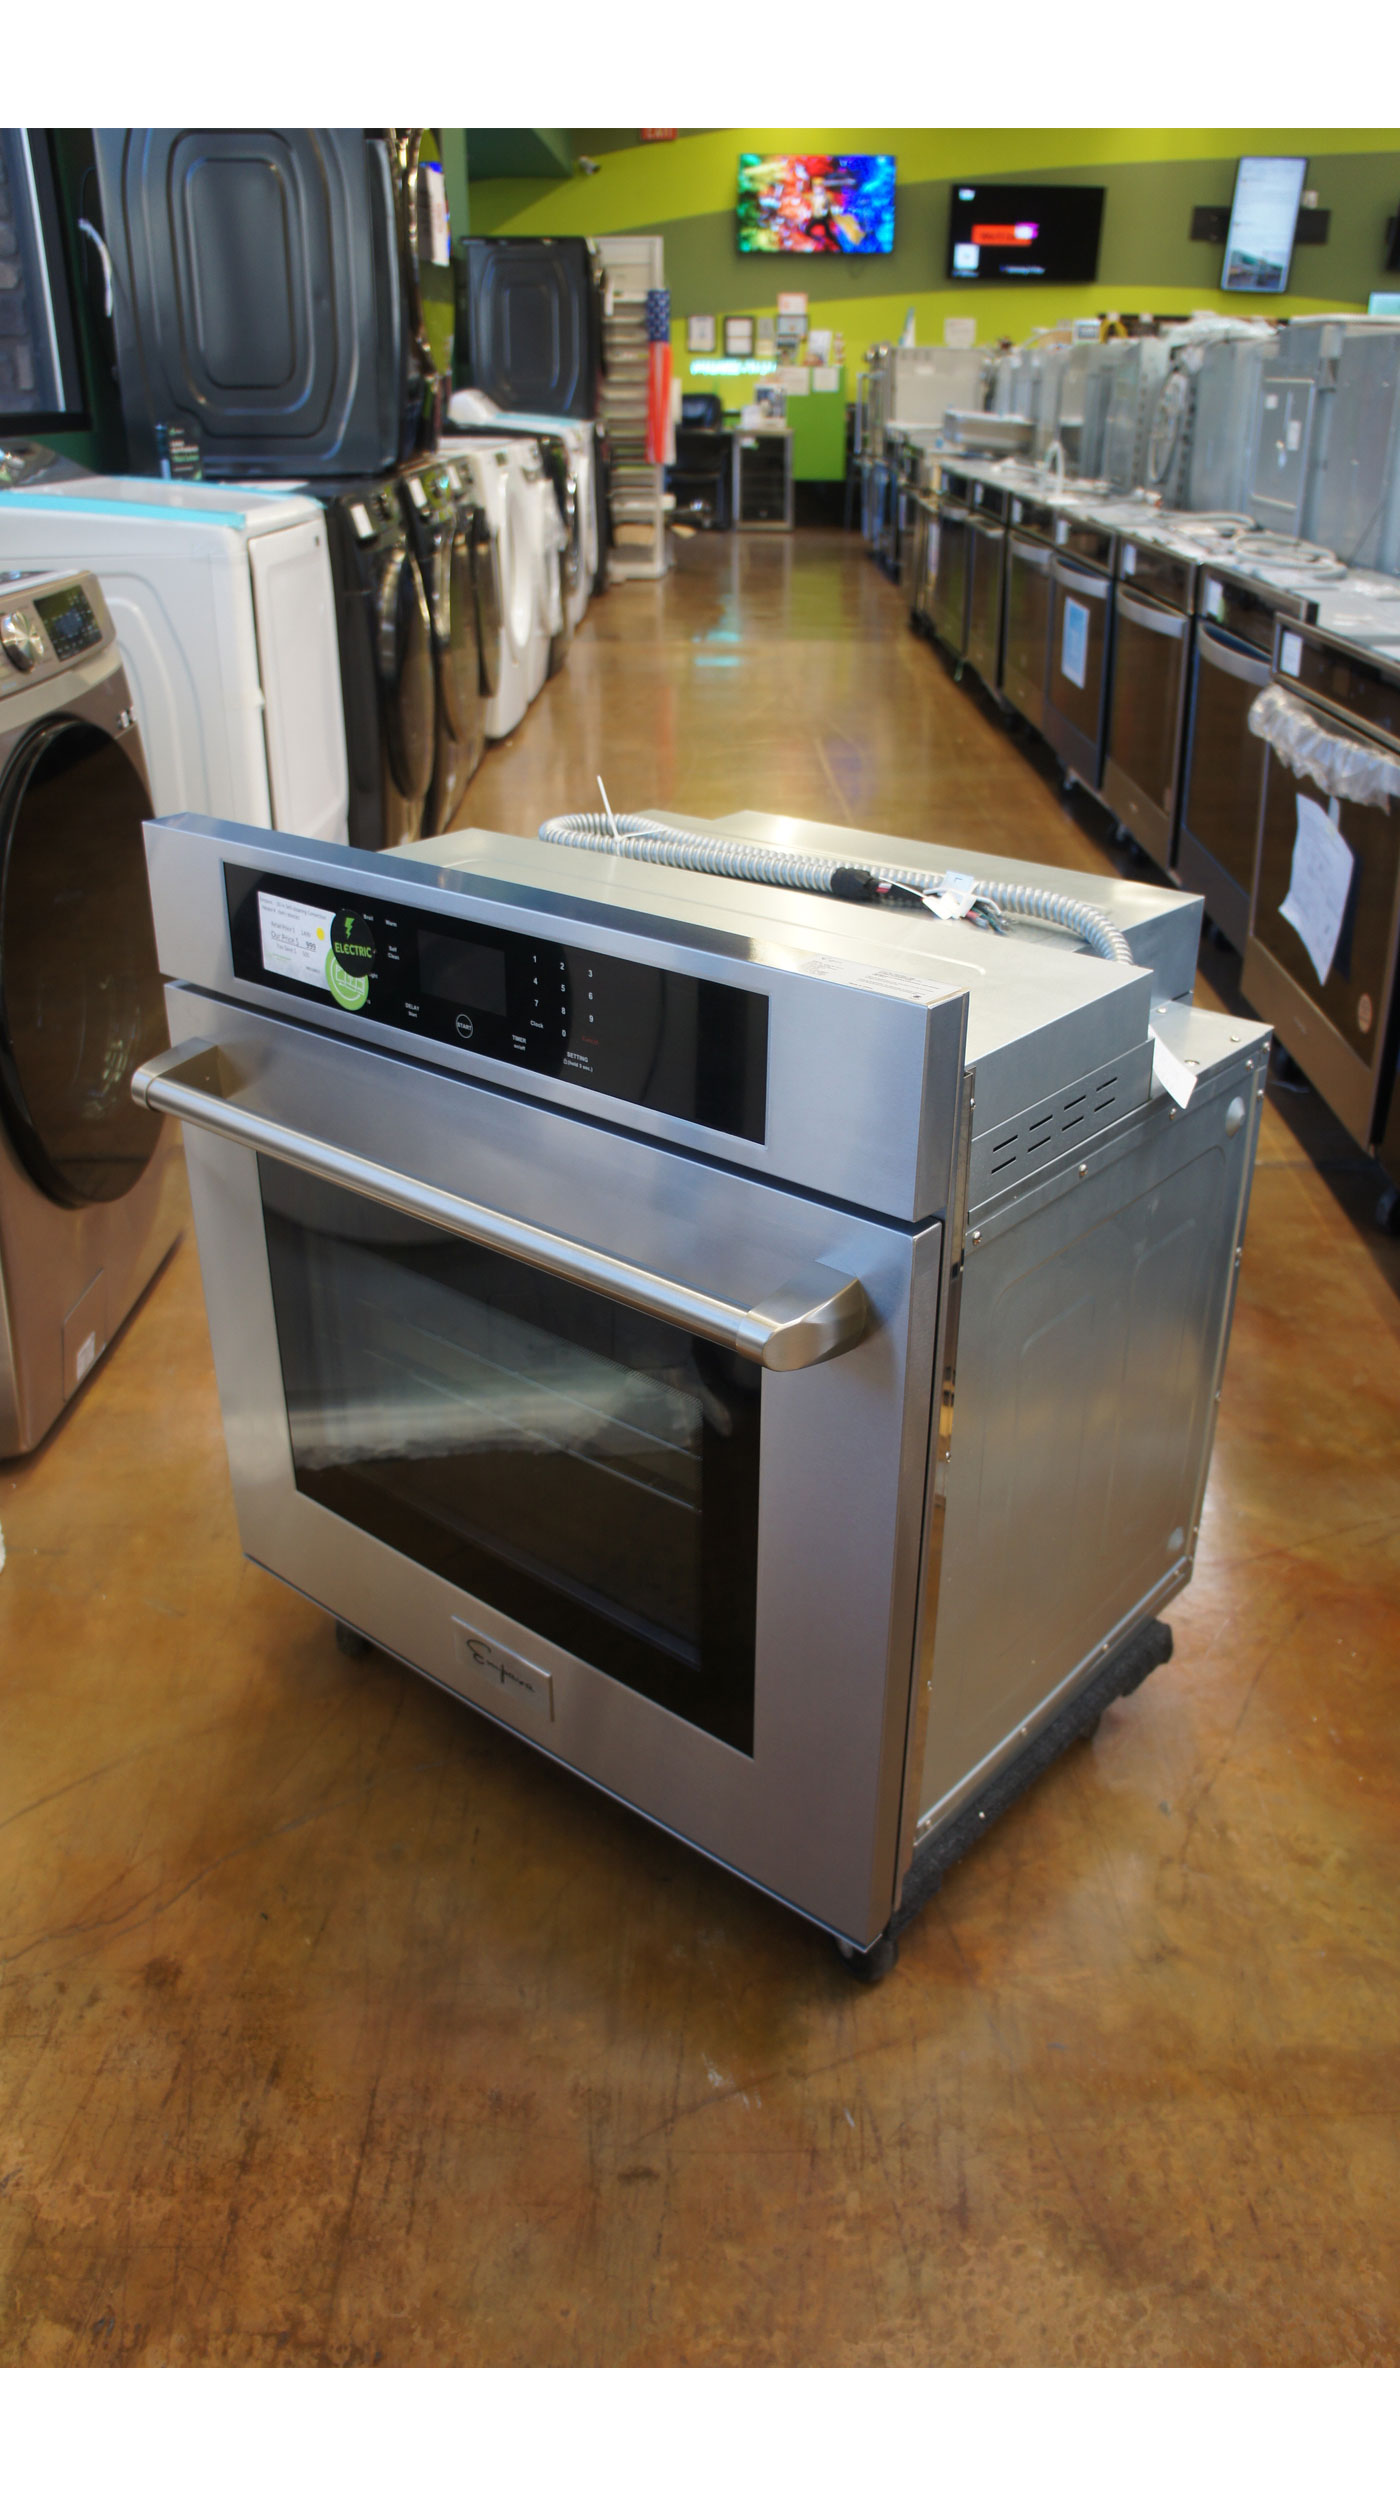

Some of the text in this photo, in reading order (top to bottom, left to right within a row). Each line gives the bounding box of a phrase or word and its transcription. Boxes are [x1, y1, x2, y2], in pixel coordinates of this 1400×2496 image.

[334, 942, 373, 959] ELECTRIC
[533, 955, 593, 978] 1 2 3
[533, 977, 594, 1000] 4 5 6
[404, 1002, 420, 1011] DELAY
[534, 999, 594, 1023] 7 8 9
[457, 1021, 472, 1031] START
[530, 1020, 544, 1029] Clock
[561, 1029, 567, 1038] 0
[566, 1051, 589, 1063] SETTING
